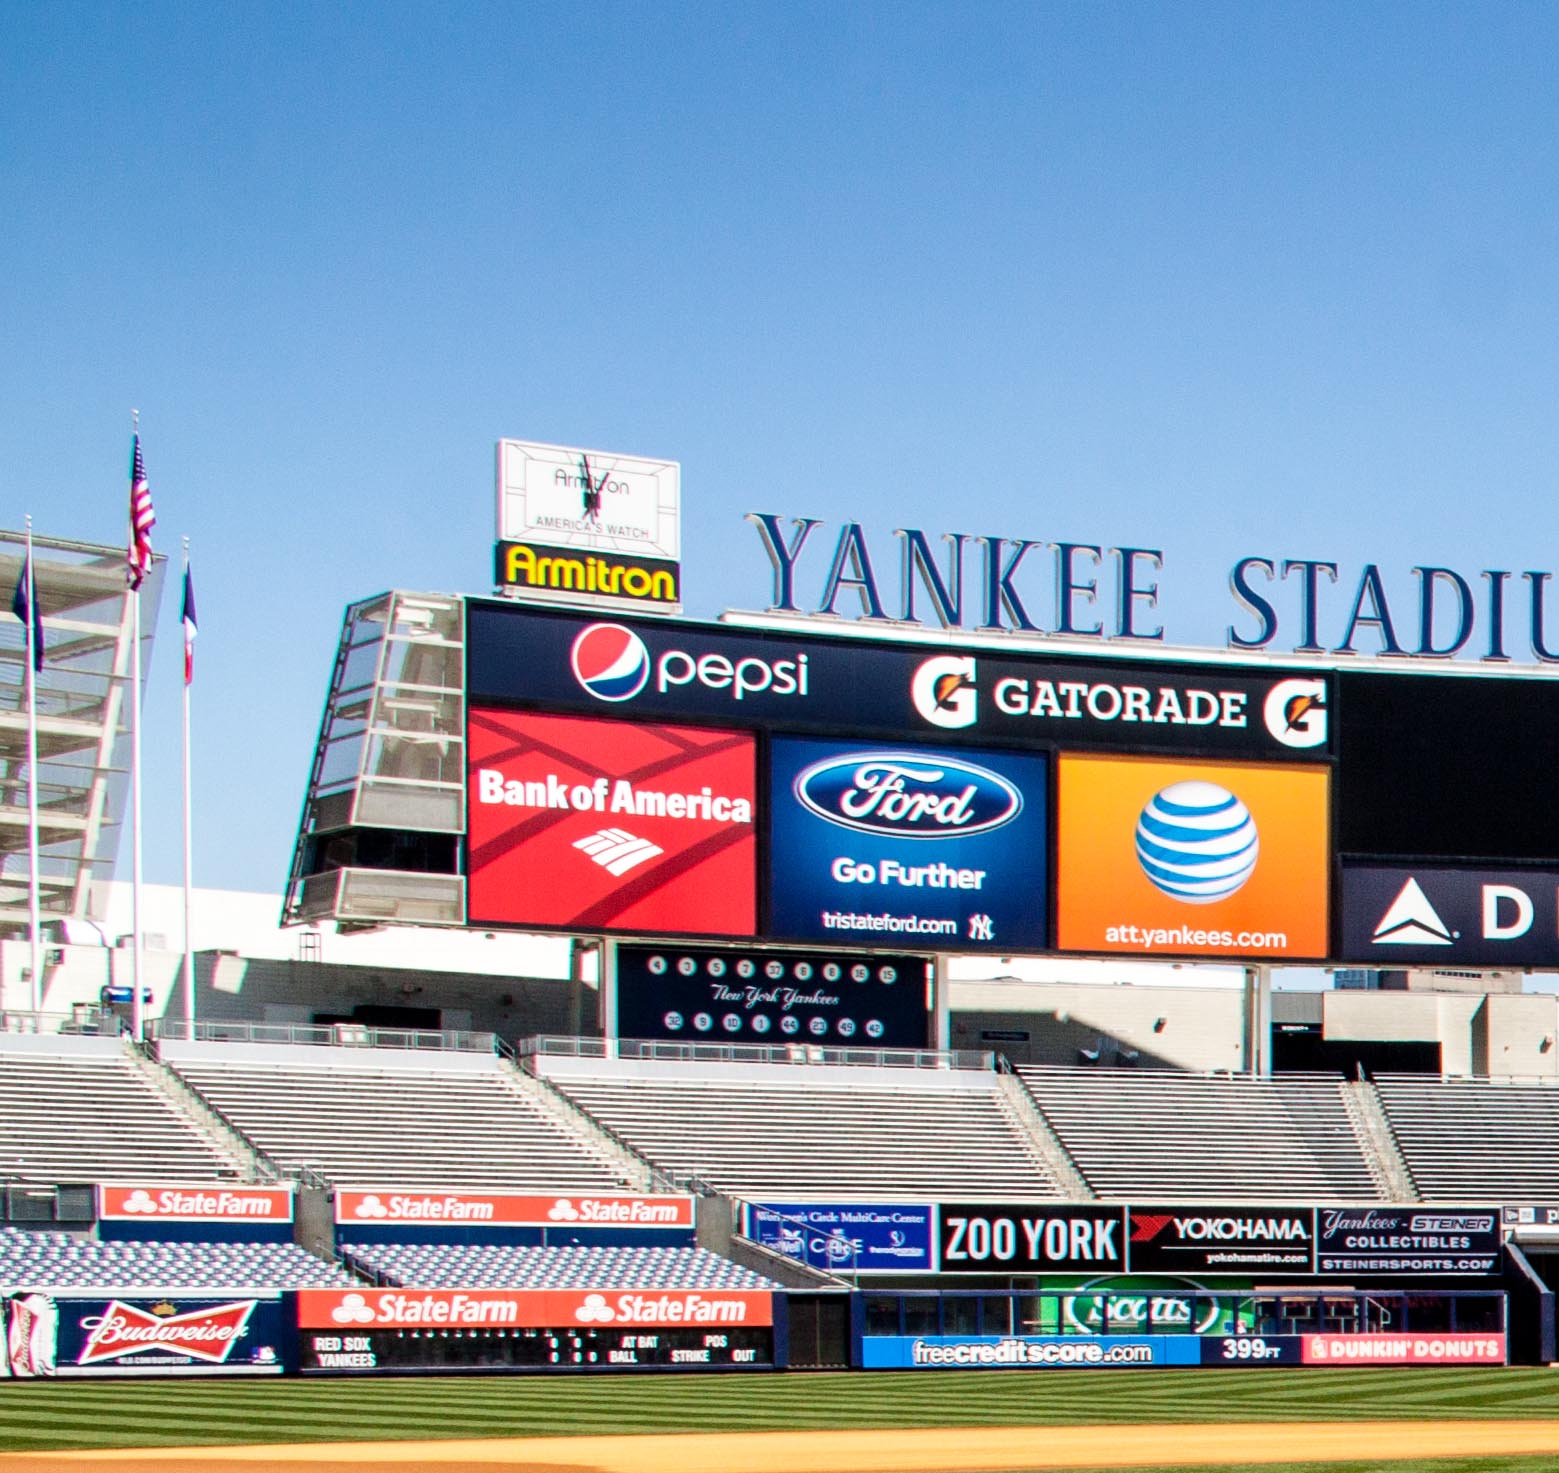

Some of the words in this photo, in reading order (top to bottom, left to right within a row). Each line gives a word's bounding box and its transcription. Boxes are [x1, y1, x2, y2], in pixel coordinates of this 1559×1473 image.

[536, 515, 603, 534] AMERICA'S
[607, 524, 649, 539] WATCH
[507, 545, 675, 601] Armitron
[744, 511, 1165, 639] YANKEE
[658, 653, 808, 701] pepsi
[996, 677, 1248, 728] GATORADE
[479, 769, 571, 811] Bank
[574, 779, 611, 812] of
[612, 781, 752, 823] America
[841, 761, 977, 825] Ford
[833, 857, 874, 885] Go
[879, 859, 987, 892] Further
[823, 910, 956, 936] tristateford.com
[1105, 923, 1287, 949] att.yankees.com
[745, 985, 780, 1009] York
[782, 987, 840, 1011] Yankees
[1323, 1210, 1399, 1239] Yankees
[1413, 1217, 1491, 1232] STEINER
[945, 1217, 1013, 1261] ZOO
[1022, 1217, 1119, 1261] YORK
[1345, 1235, 1471, 1249] COLLECTIBLES
[1207, 1252, 1308, 1265] yokohamatire.com
[1323, 1258, 1494, 1270] STEINERSPORTS.COM
[80, 1316, 250, 1345] Budweiser
[621, 1335, 636, 1348] AT
[637, 1335, 659, 1348] BAT
[703, 1334, 728, 1348] POS
[314, 1337, 341, 1351] RED
[343, 1337, 371, 1351] SOX
[609, 1350, 638, 1363] BALL
[670, 1349, 711, 1363] STRIKE
[732, 1349, 756, 1362] OUT
[913, 1339, 1153, 1366] freecreditscore.com
[1330, 1340, 1412, 1358] DUNKIN'
[1414, 1339, 1499, 1358] DONUTS
[319, 1353, 376, 1368] YANKEES
